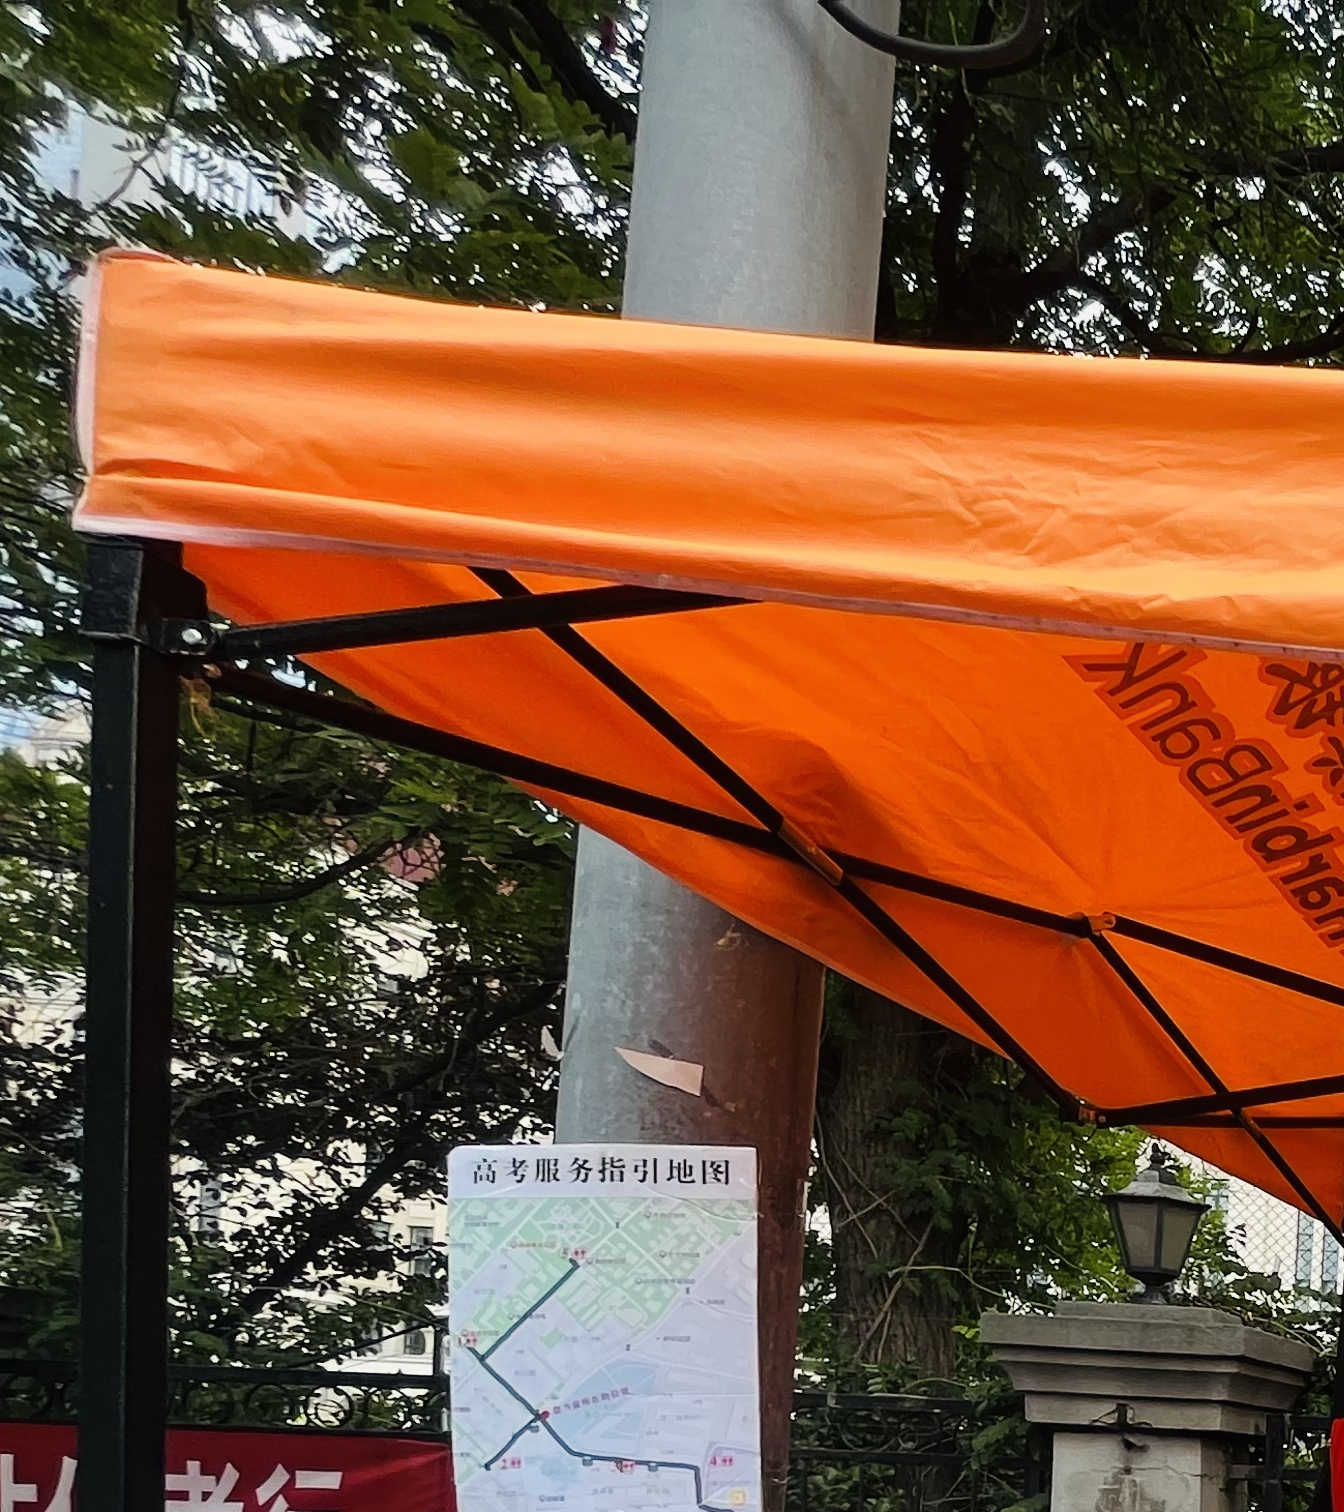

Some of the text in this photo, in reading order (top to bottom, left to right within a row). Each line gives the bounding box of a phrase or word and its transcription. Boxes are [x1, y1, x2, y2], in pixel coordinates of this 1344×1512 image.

[472, 1157, 731, 1186] 高考服务指引地图
